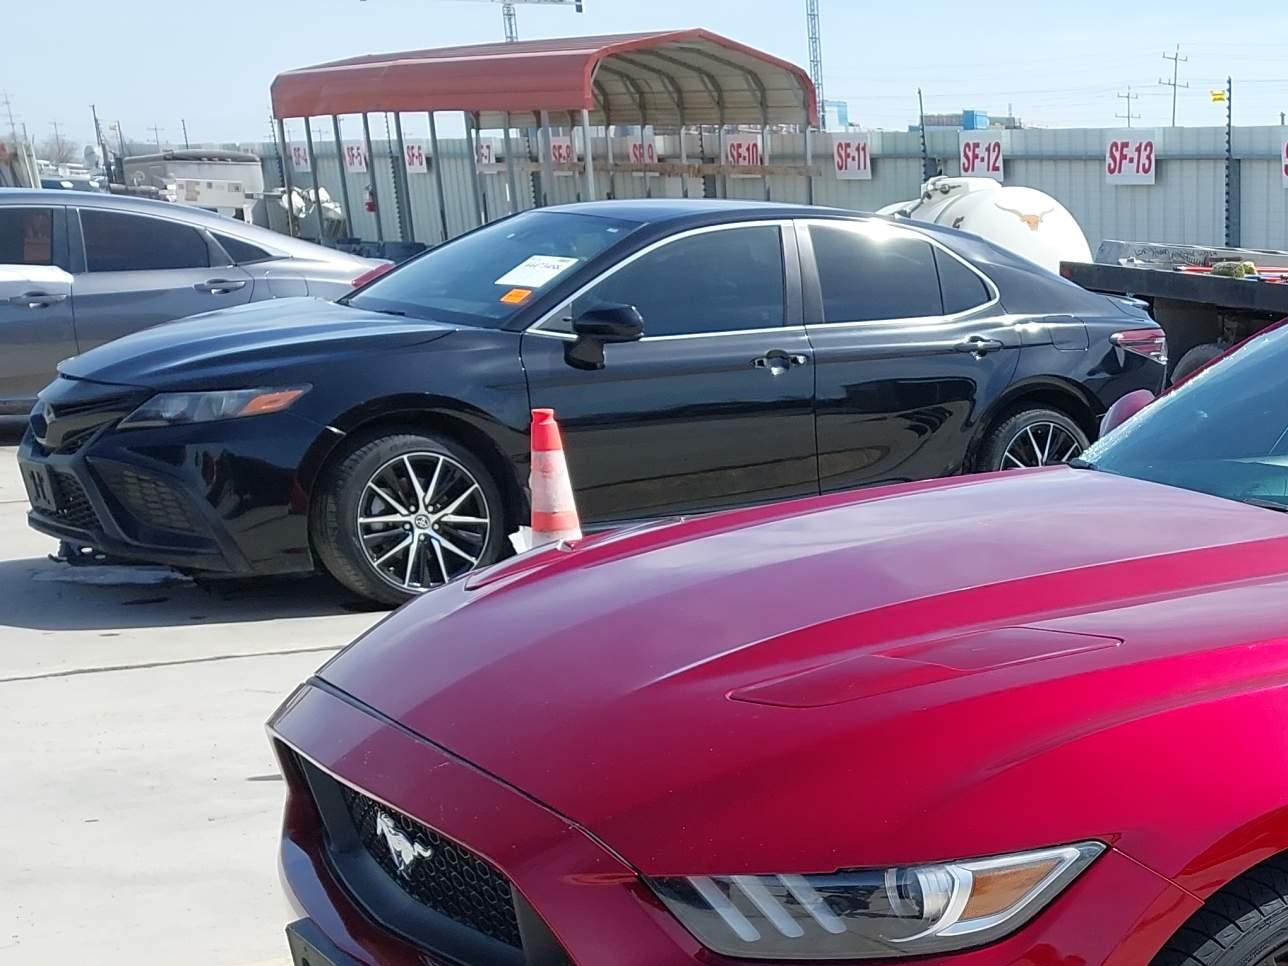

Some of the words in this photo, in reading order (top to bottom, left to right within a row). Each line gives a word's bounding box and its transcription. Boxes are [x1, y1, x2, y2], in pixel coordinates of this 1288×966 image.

[406, 145, 423, 167] SF-6
[729, 142, 759, 166] SF-10
[836, 142, 867, 171] SF-11
[962, 141, 1001, 173] SF-12
[1107, 140, 1154, 175] SF-13
